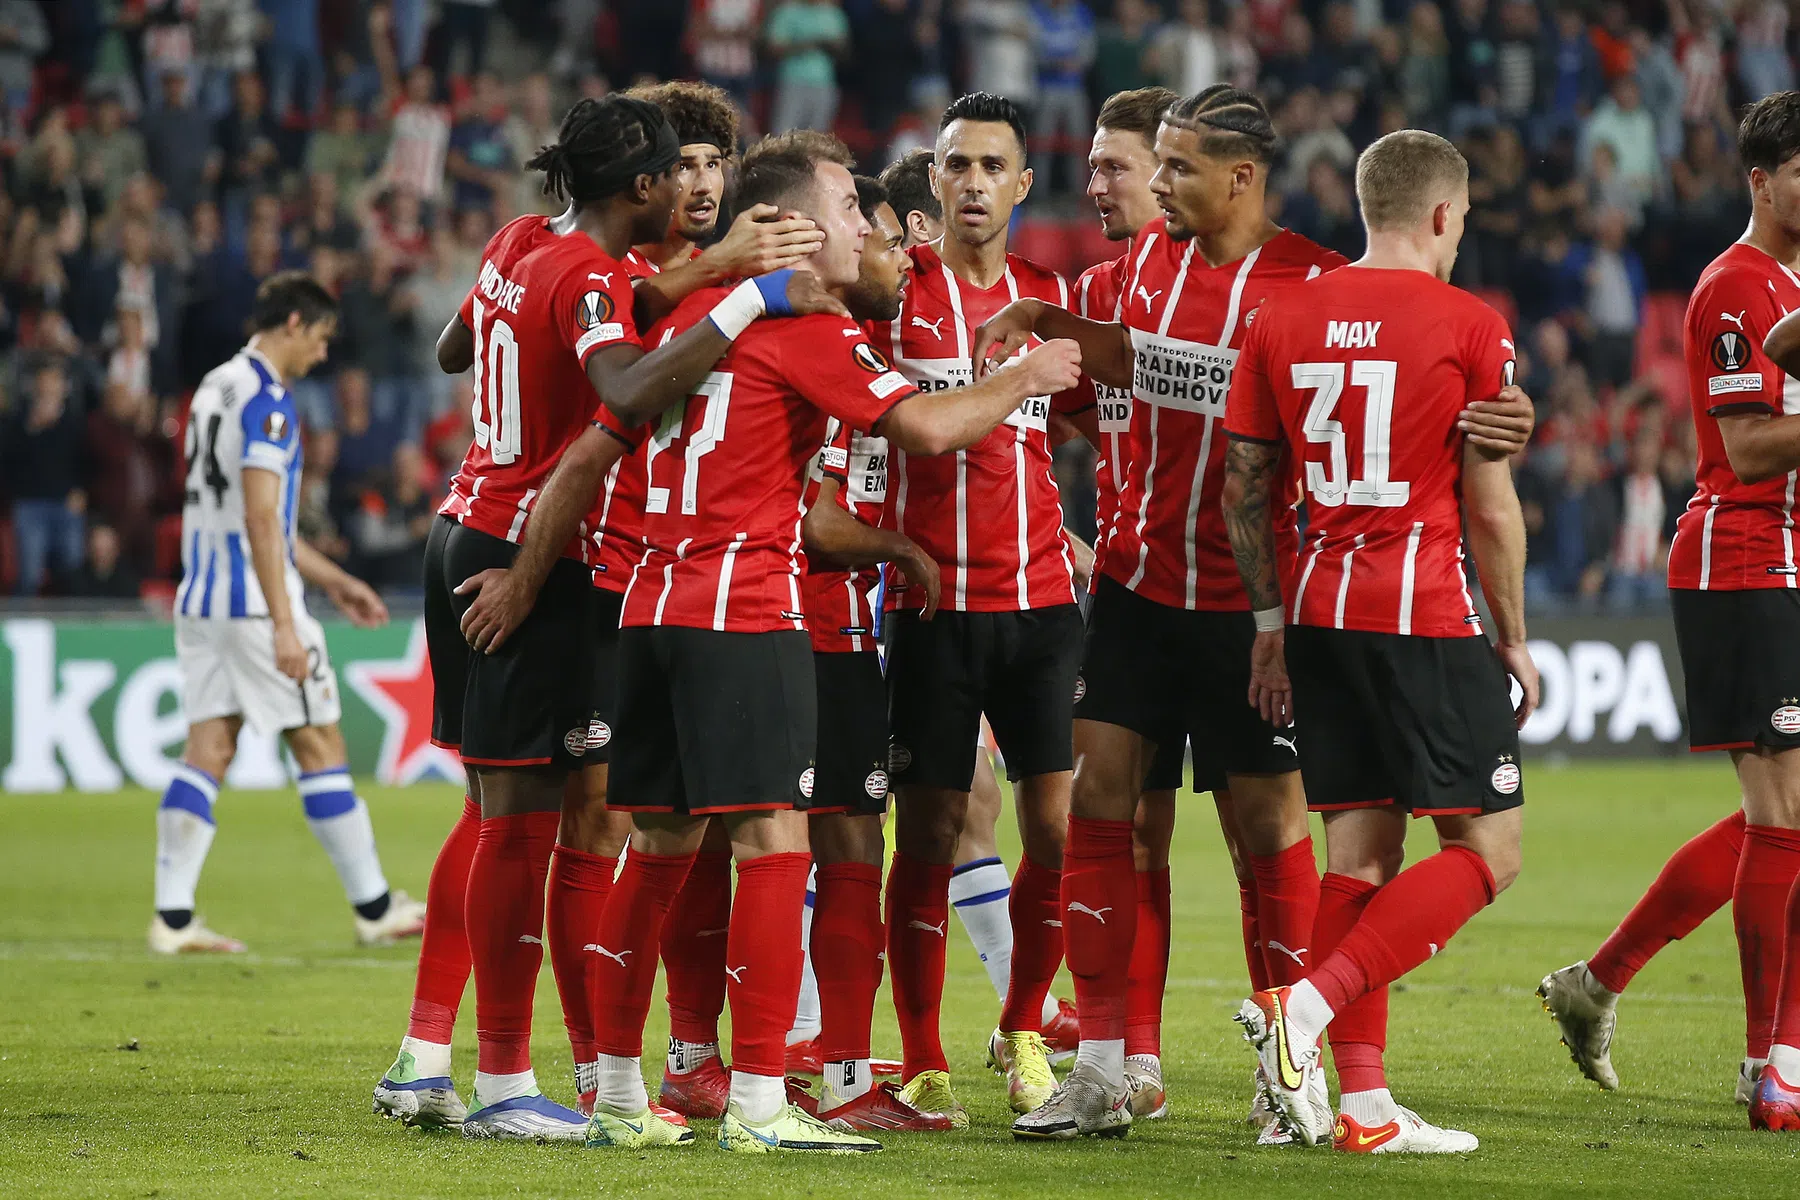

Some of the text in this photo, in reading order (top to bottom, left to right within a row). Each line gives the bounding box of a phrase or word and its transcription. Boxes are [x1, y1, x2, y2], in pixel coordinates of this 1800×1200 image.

[478, 258, 526, 315] MADEKE
[1325, 320, 1382, 349] MAX
[1137, 351, 1231, 384] RAINPO
[1146, 344, 1232, 365] METROPOOLREGIO
[471, 294, 522, 465] 10
[1134, 370, 1230, 405] EINDHOV
[1711, 379, 1760, 388] FOUNDATION
[1099, 403, 1128, 421] ND
[1291, 360, 1410, 507] 31
[183, 411, 229, 511] 24
[867, 455, 888, 471] BR
[2, 618, 301, 793] ke
